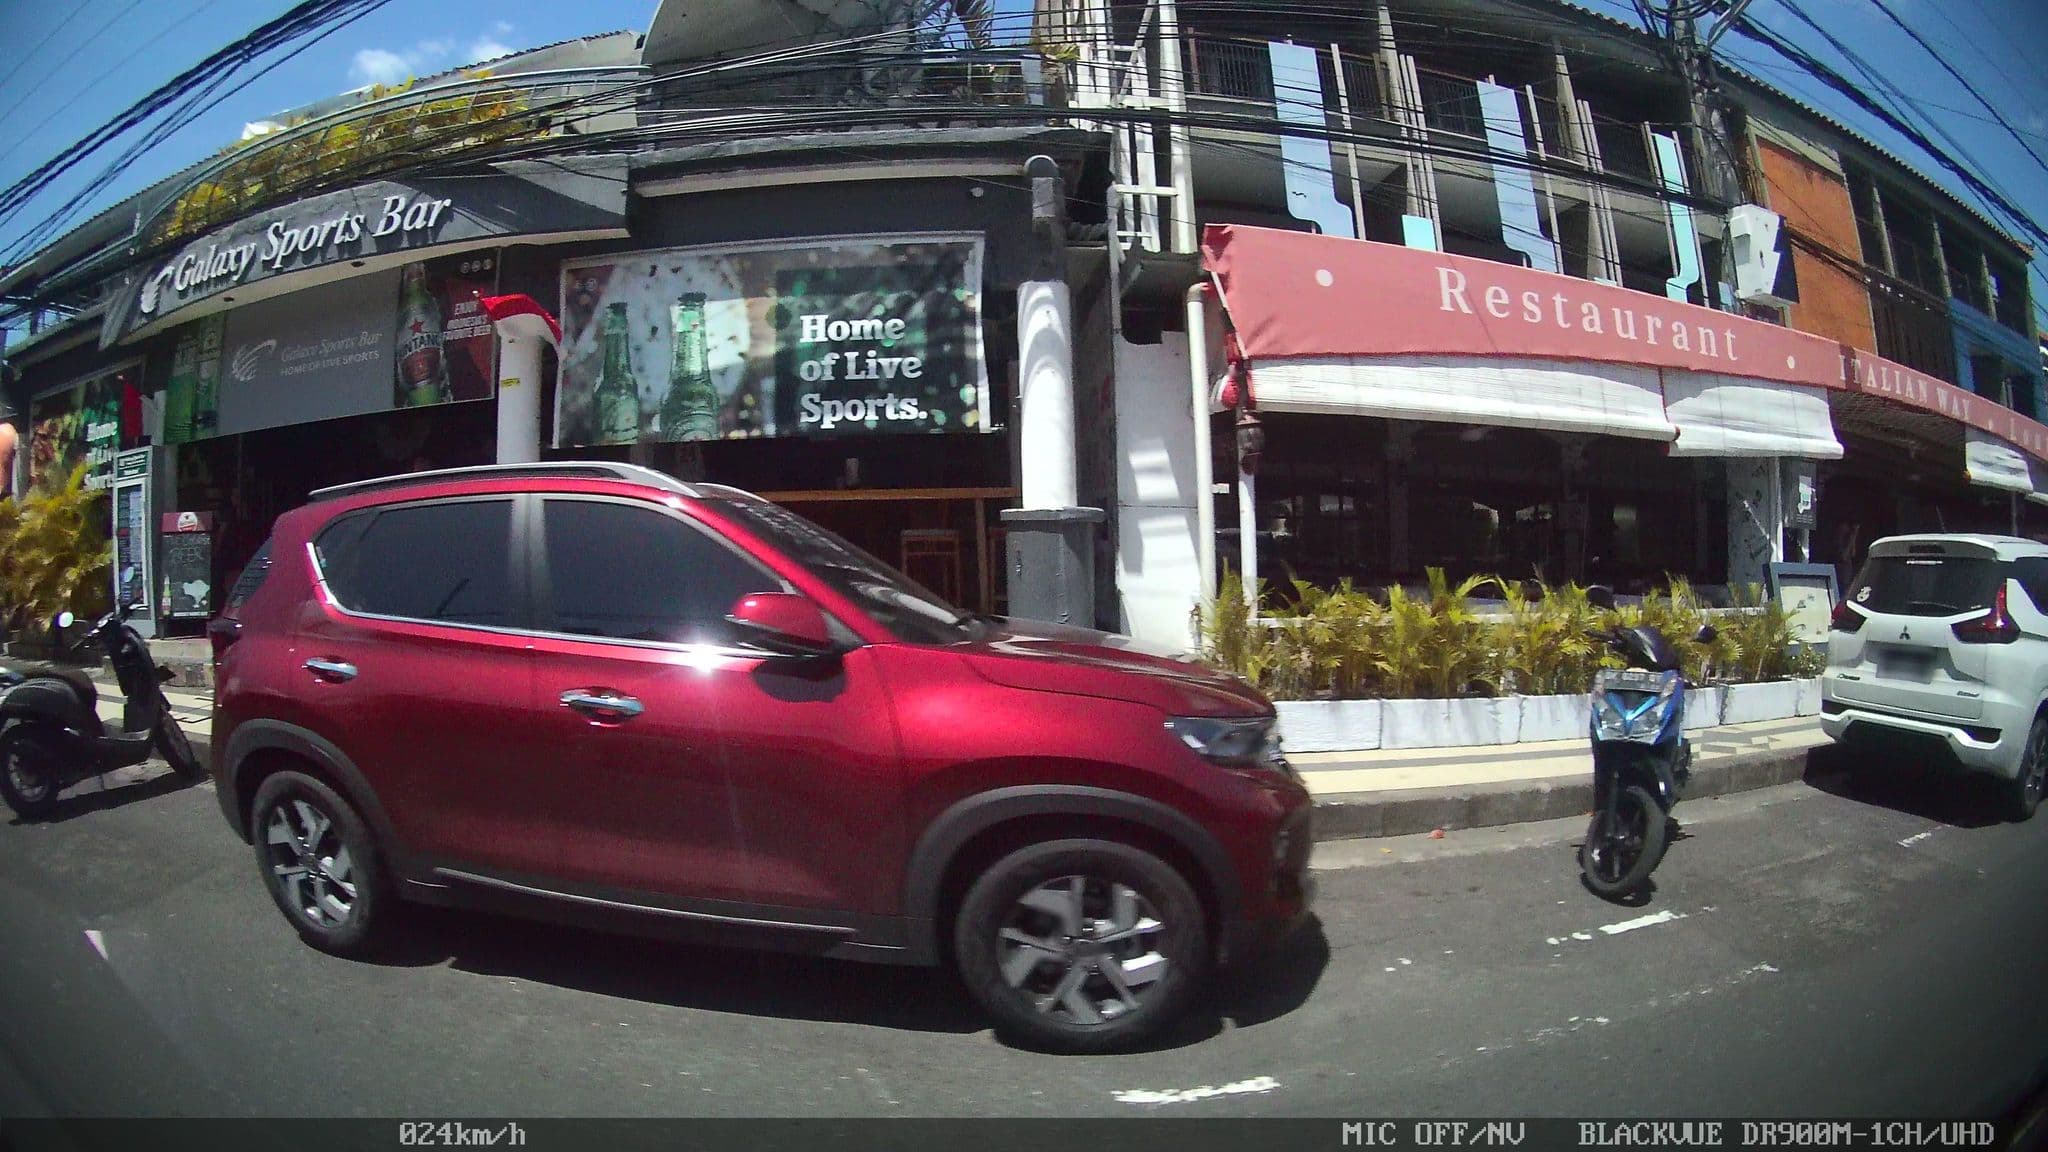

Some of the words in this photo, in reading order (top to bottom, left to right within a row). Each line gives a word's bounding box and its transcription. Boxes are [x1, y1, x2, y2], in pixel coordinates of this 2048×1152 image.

[175, 242, 257, 291] Galaxy
[261, 210, 364, 269] Sports
[372, 195, 451, 237] Bar
[800, 314, 906, 343] Home
[1435, 266, 1739, 361] Restaurant
[359, 331, 383, 347] Bar
[281, 364, 308, 377] HOME
[322, 356, 343, 368] LIVE
[343, 350, 380, 366] SPORTS
[800, 352, 840, 381] of
[845, 351, 923, 381] Live
[1839, 355, 1928, 403] ITALIAN
[1936, 387, 1971, 421] WAY
[800, 392, 927, 429] Sports.
